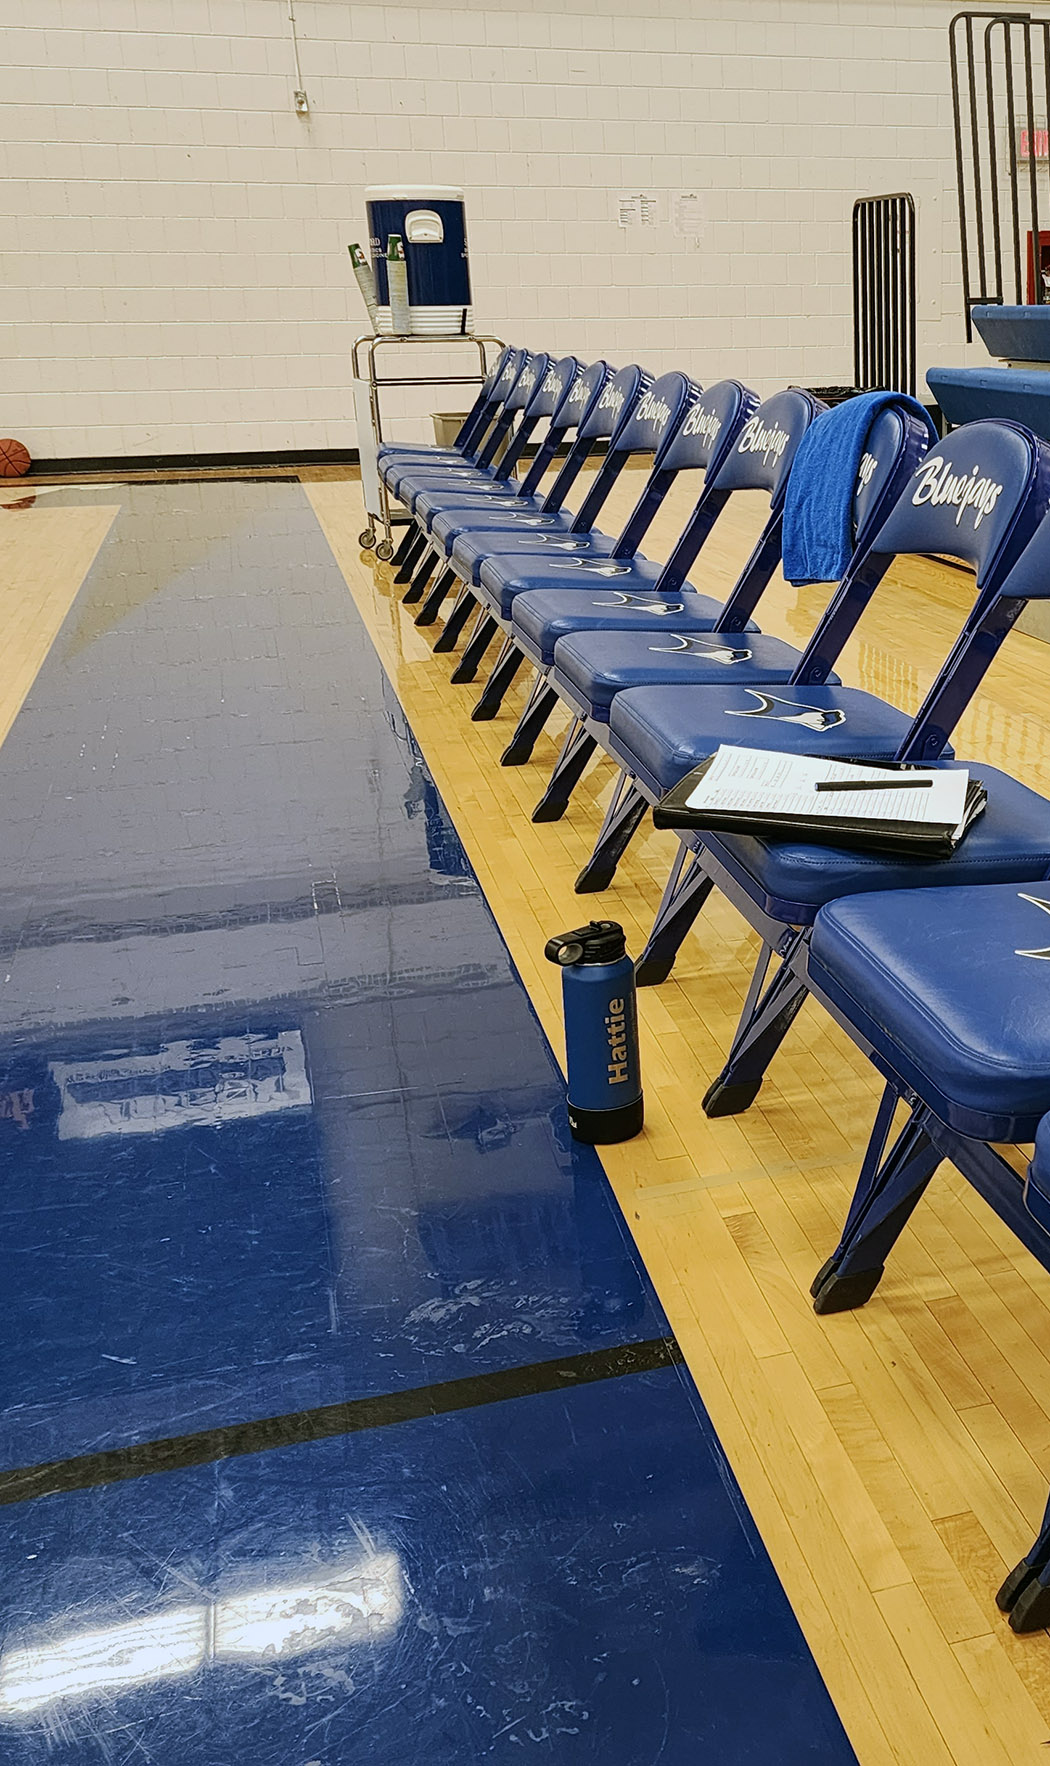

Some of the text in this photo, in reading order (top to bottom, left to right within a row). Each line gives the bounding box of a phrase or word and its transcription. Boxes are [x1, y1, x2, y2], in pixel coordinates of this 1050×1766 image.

[737, 416, 790, 468] Bluejays
[911, 455, 1003, 529] Bluejays
[605, 998, 628, 1084] Hattie
